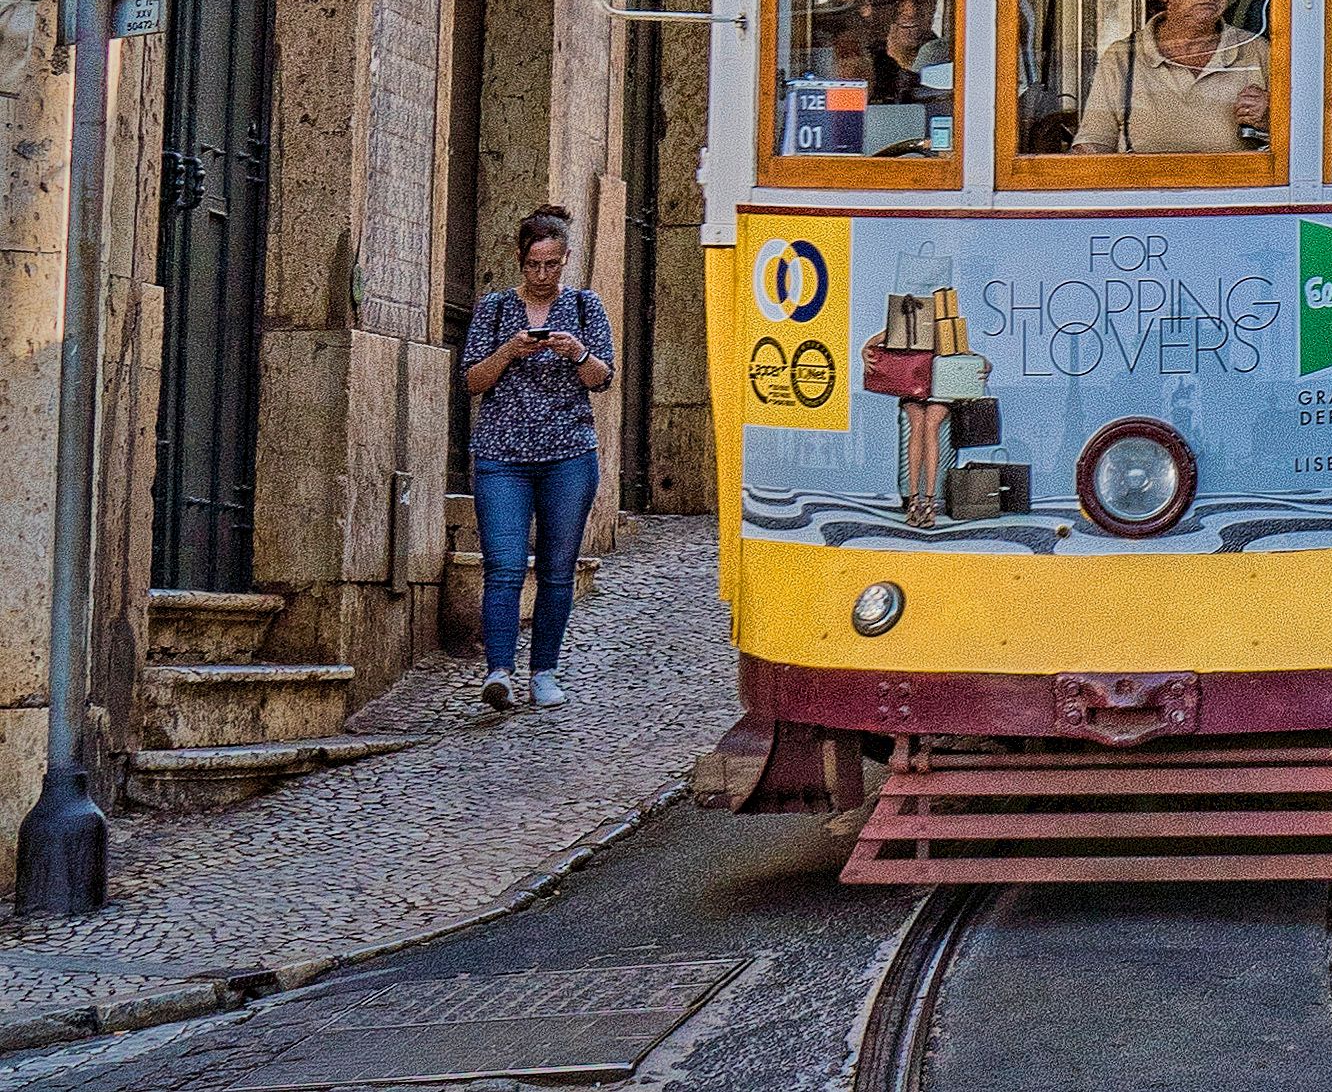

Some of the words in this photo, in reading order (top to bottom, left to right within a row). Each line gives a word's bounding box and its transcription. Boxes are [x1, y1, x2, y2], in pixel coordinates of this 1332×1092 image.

[800, 95, 826, 110] 12E
[800, 126, 822, 149] 01
[1089, 234, 1170, 273] FOR
[983, 276, 1281, 337] SHOPPING
[1305, 277, 1332, 309] El
[1022, 315, 1261, 377] LOVERS
